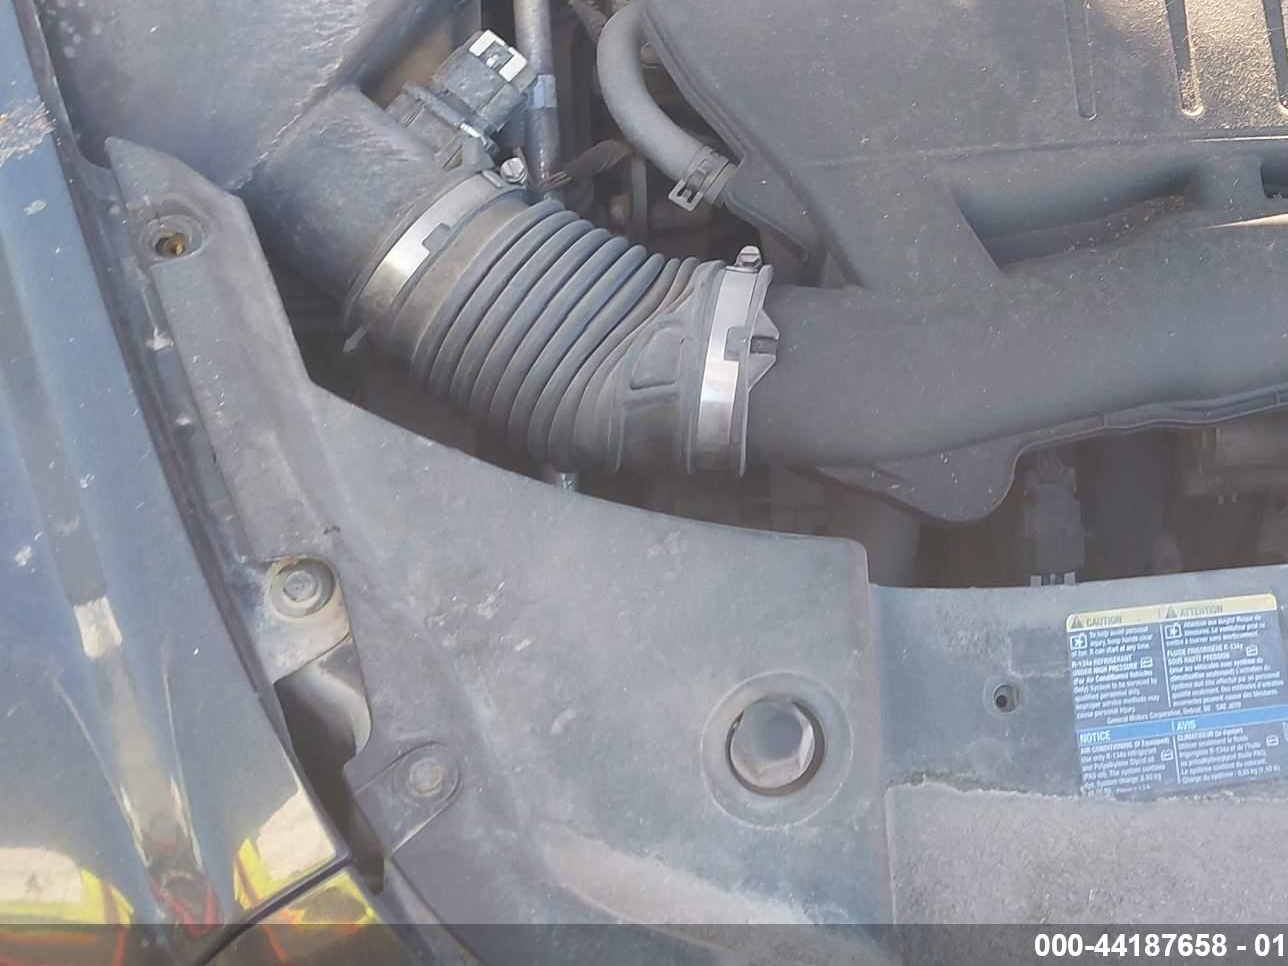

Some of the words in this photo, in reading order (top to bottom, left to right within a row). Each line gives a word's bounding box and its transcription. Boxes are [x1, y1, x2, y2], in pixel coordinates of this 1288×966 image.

[1086, 616, 1122, 627] CAUTION
[1177, 719, 1196, 732] AVIS
[1080, 730, 1111, 744] NOTICE
